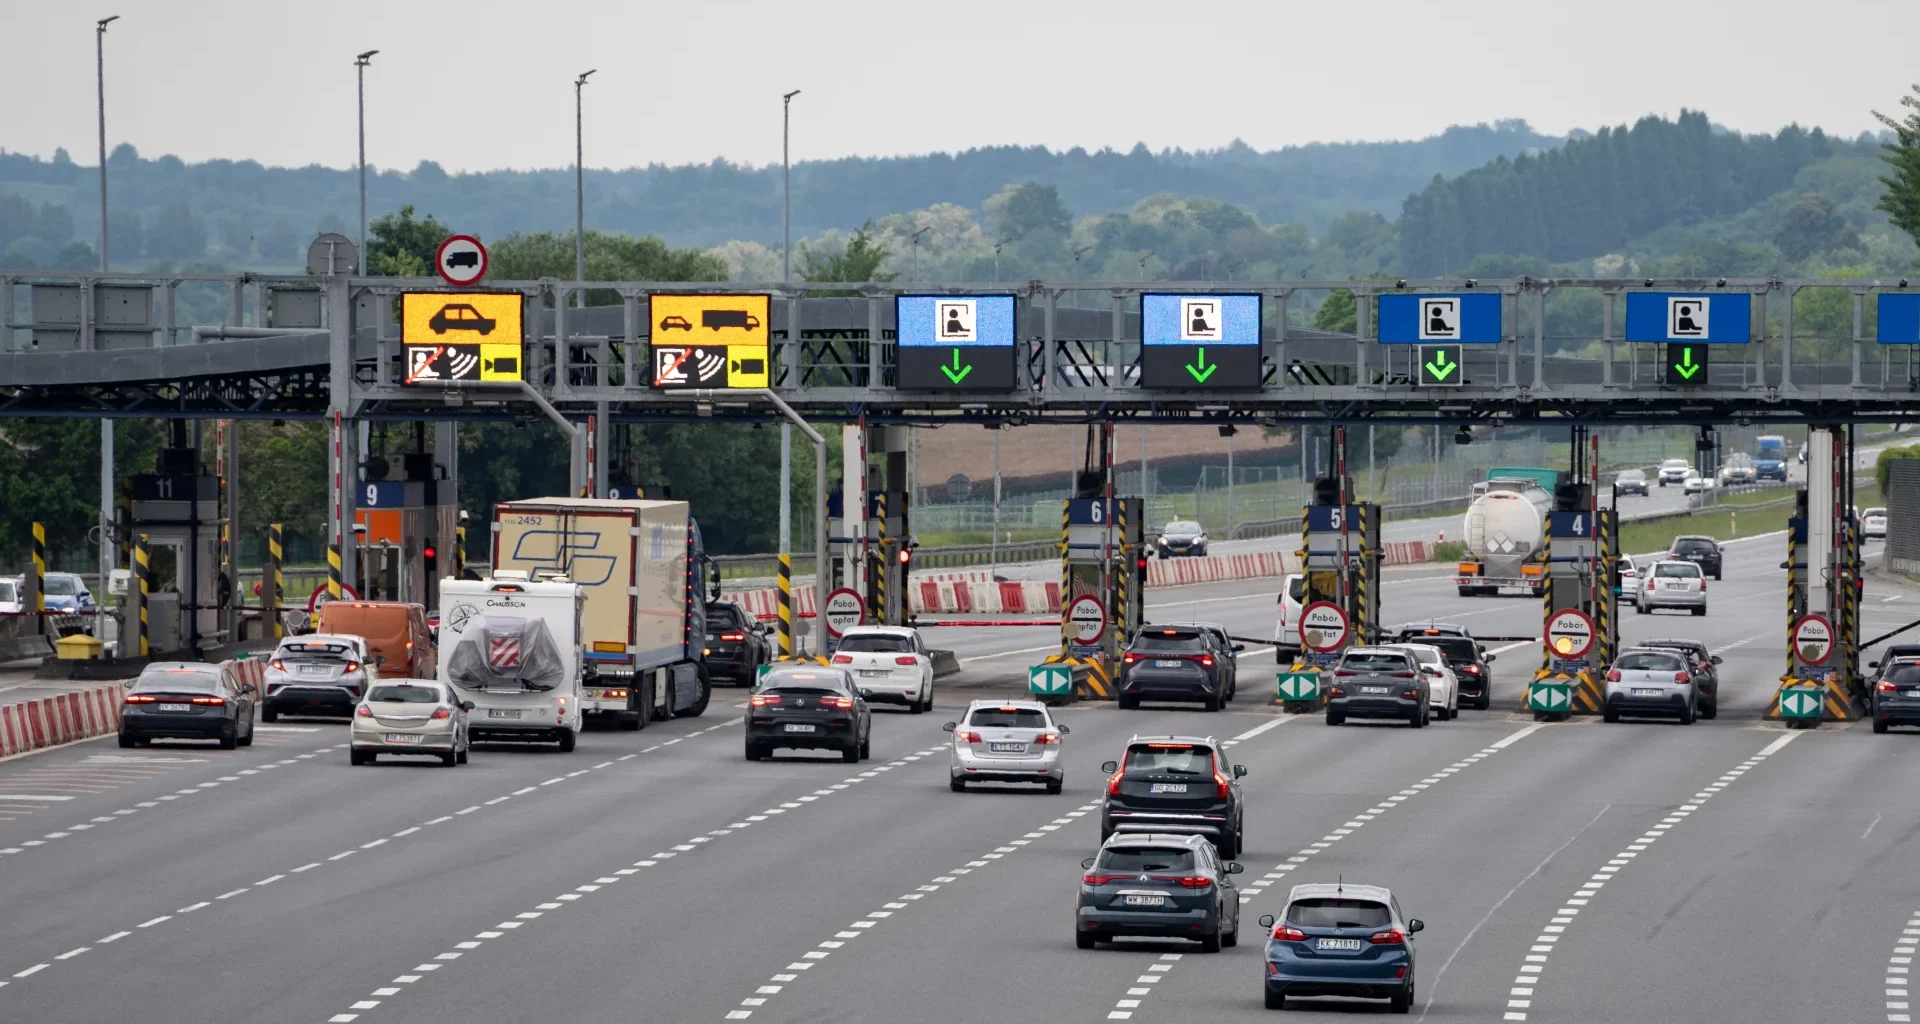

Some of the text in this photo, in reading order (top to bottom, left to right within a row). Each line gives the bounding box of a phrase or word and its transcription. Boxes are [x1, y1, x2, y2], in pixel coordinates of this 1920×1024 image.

[156, 478, 172, 498] 11
[366, 484, 378, 506] 9
[1091, 501, 1102, 523] 6
[517, 516, 543, 526] 2452
[1331, 508, 1341, 529] 5
[1572, 514, 1584, 536] 4
[833, 599, 856, 608] Pobór
[833, 616, 855, 626] opłat
[1078, 621, 1097, 632] płat
[1140, 896, 1163, 905] 387TH
[1320, 939, 1359, 948] KK 71818
